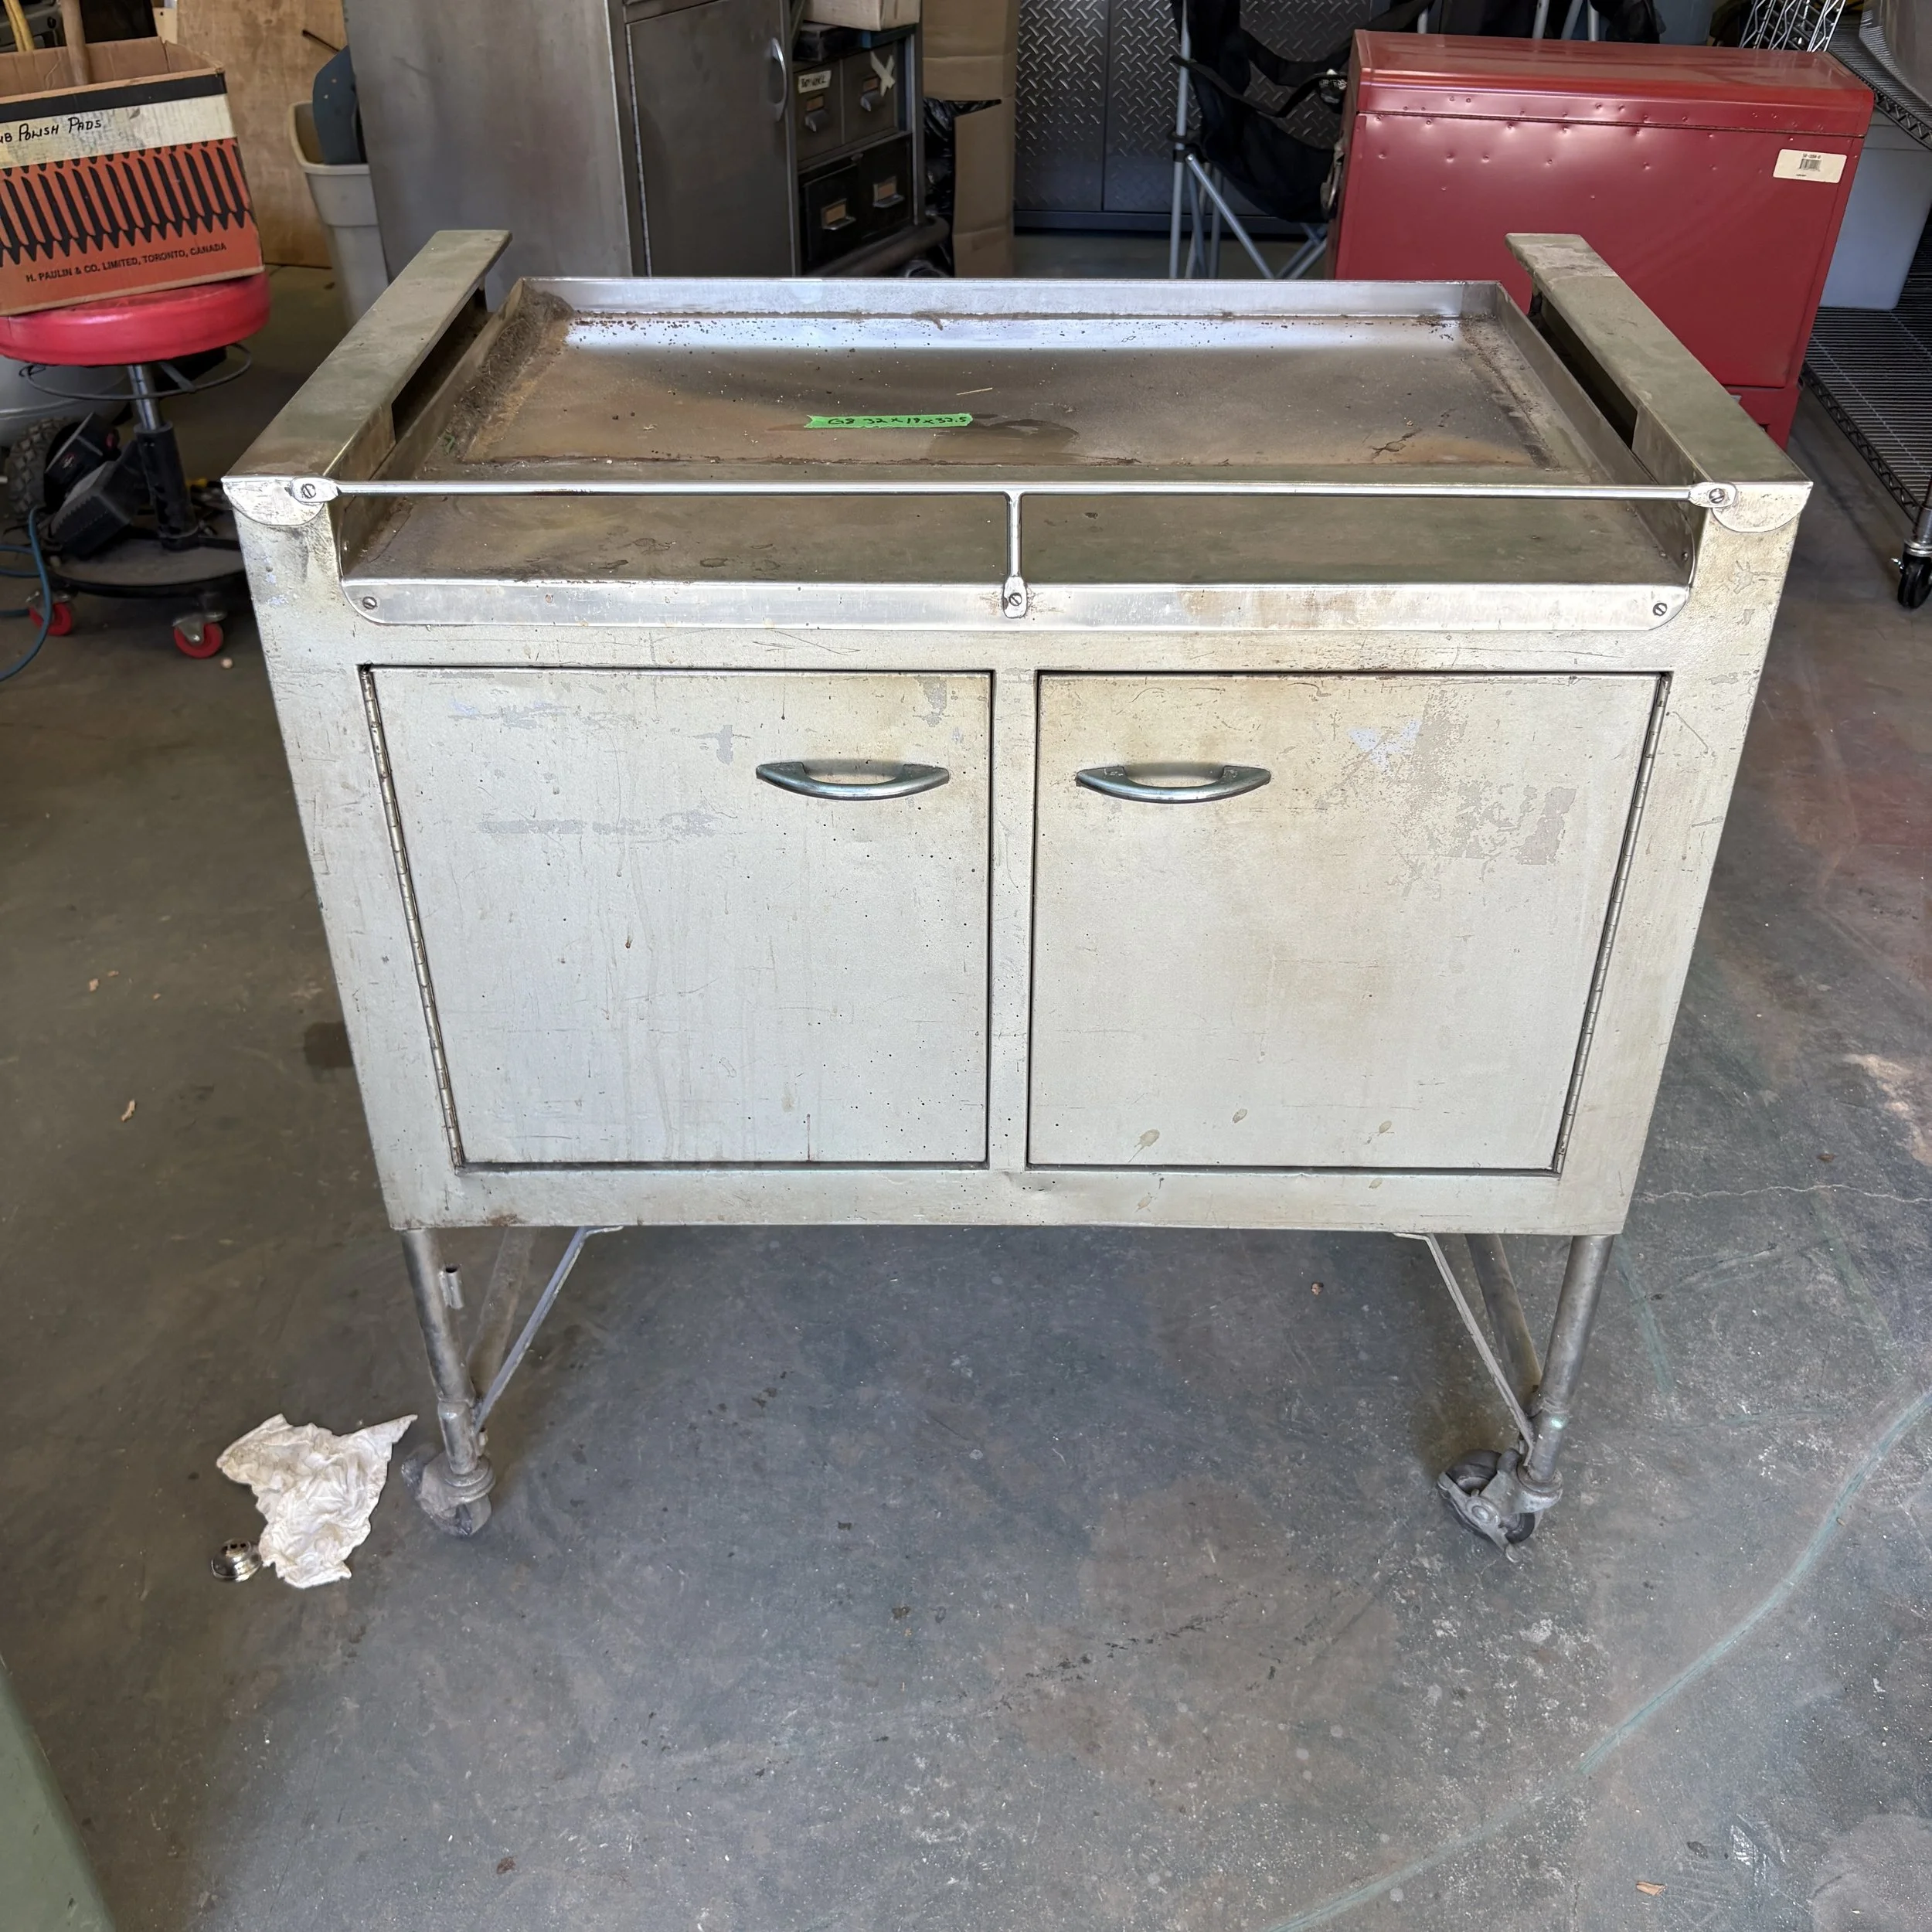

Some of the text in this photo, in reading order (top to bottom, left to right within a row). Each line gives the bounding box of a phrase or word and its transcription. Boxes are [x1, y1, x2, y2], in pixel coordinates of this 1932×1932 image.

[26, 274, 37, 282] H.
[38, 267, 73, 281] PAULIN
[83, 264, 101, 273] CO.
[102, 257, 141, 270] LIMITED,
[141, 250, 189, 264] TORONTO,
[190, 242, 226, 255] CANADA
